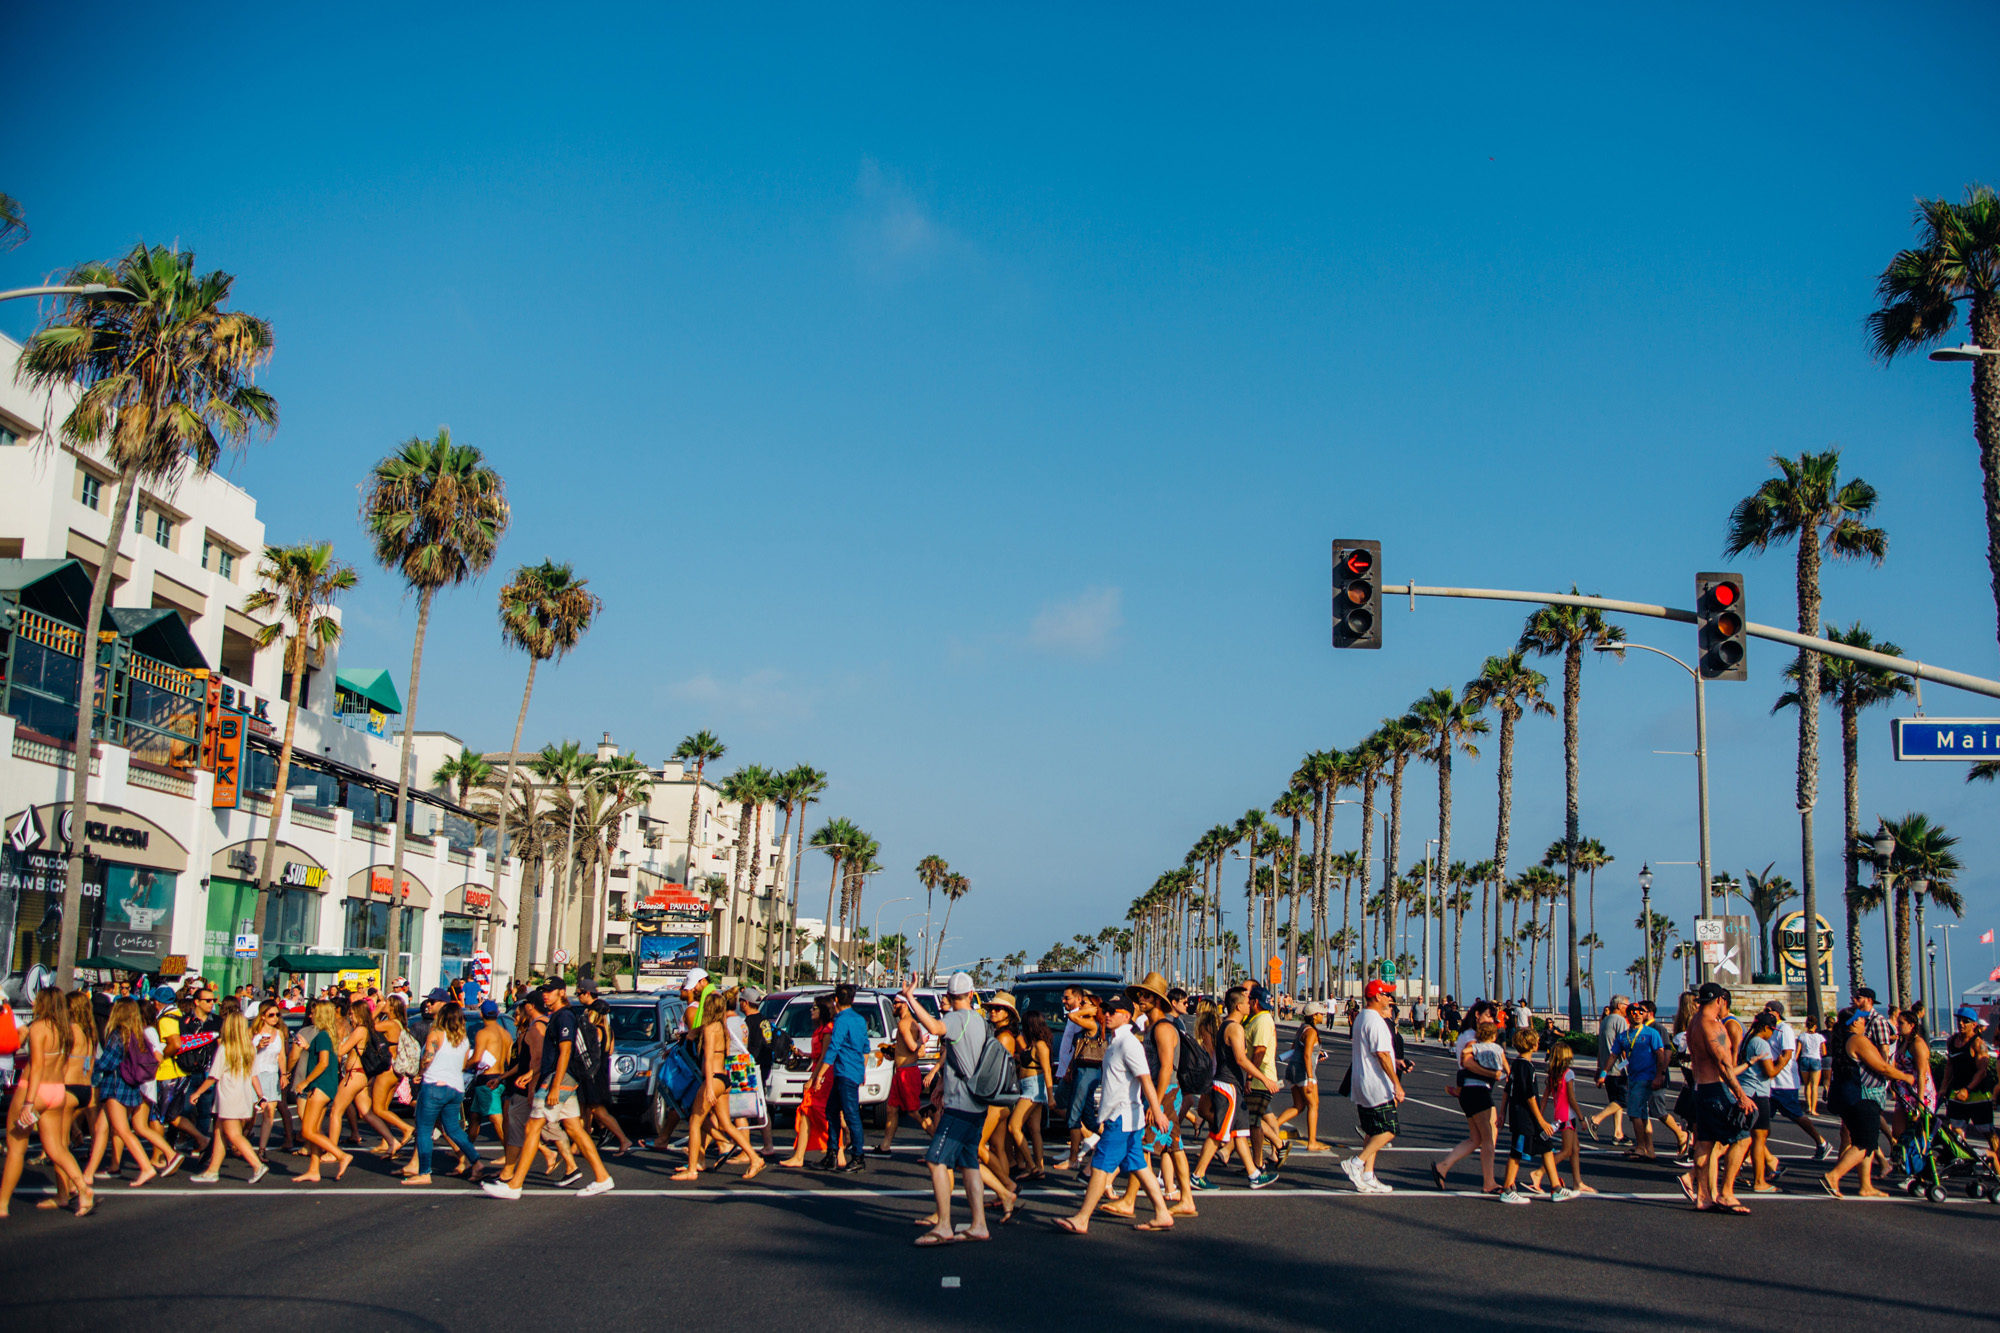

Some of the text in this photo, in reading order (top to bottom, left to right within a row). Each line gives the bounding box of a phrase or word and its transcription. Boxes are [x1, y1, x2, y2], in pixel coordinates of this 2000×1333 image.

[220, 684, 270, 719] BLK
[0, 872, 46, 891] EANS
[286, 862, 328, 888] SUBWAY
[669, 903, 705, 911] PAVILION
[1725, 921, 1749, 937] dy's
[1783, 930, 1834, 948] DUE'S
